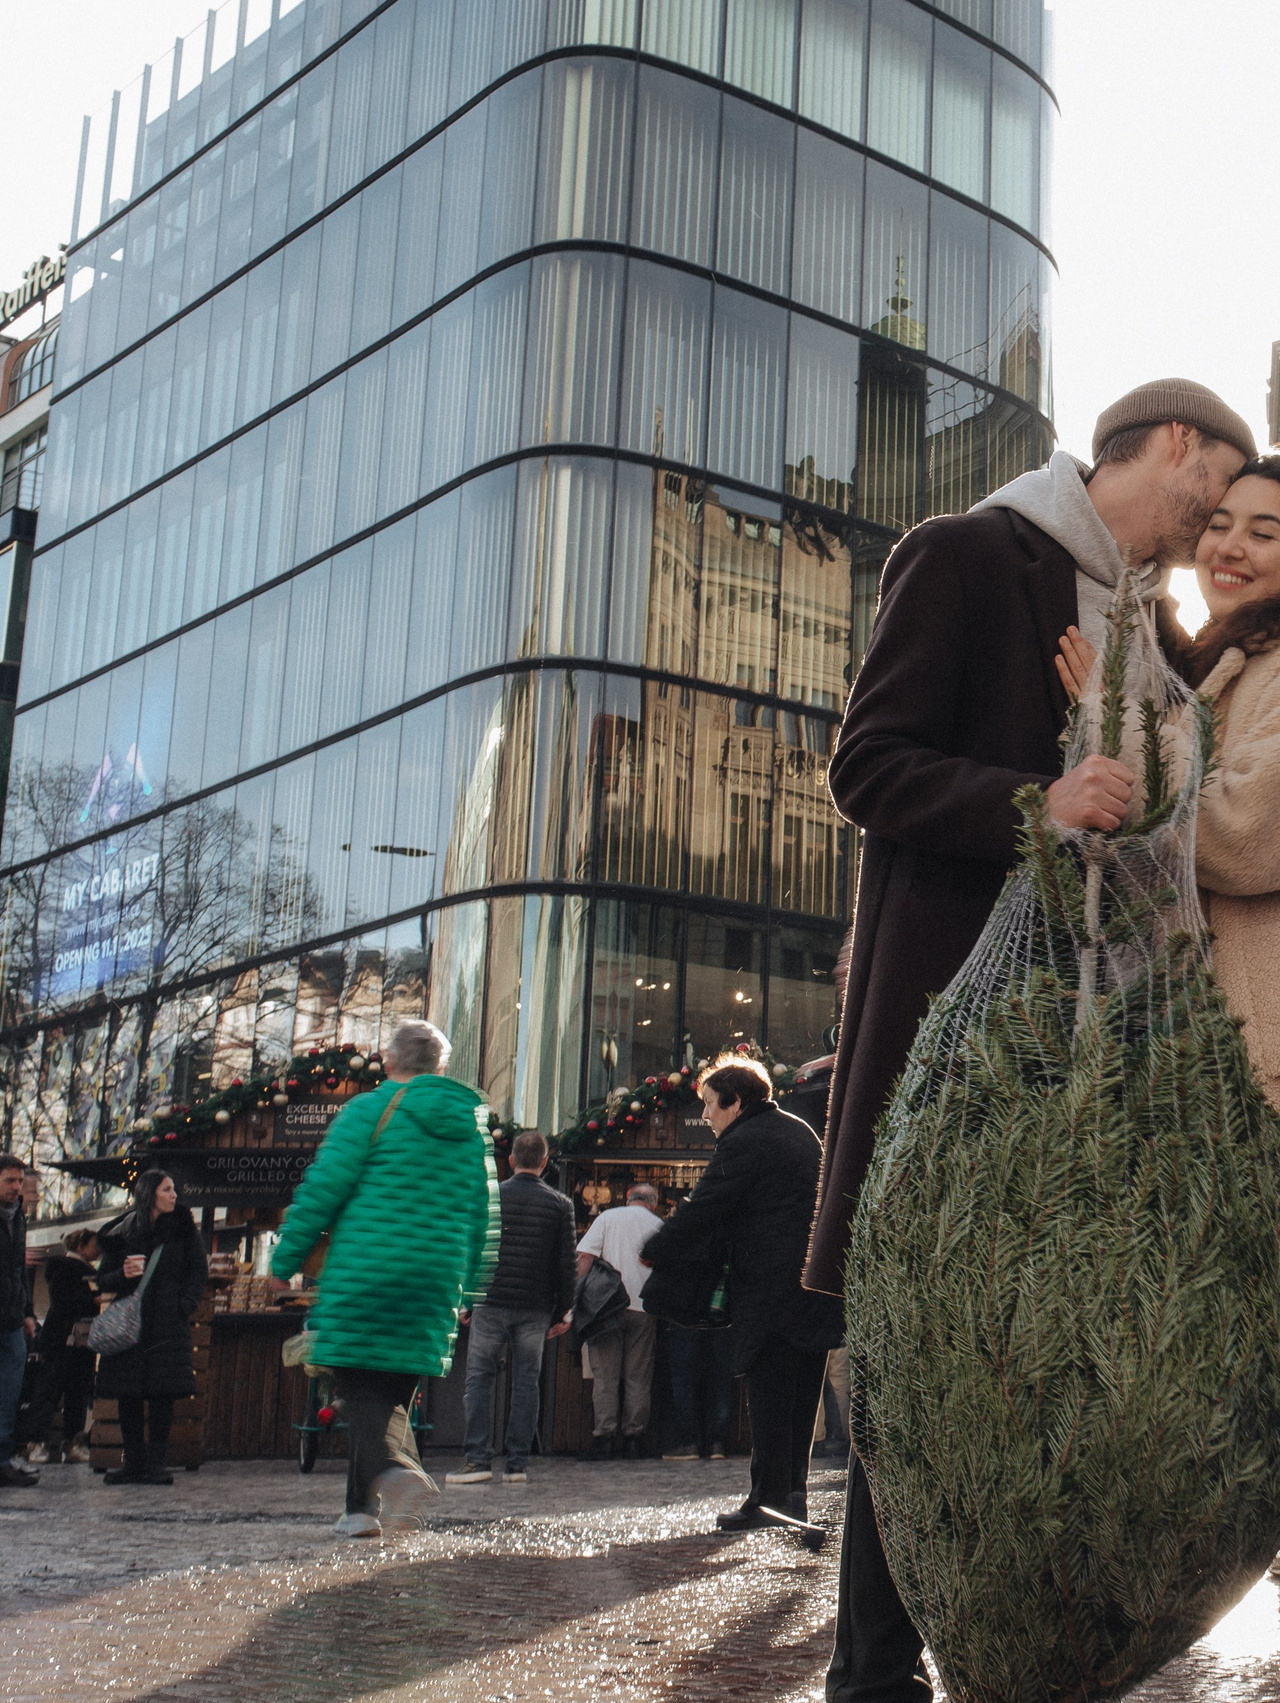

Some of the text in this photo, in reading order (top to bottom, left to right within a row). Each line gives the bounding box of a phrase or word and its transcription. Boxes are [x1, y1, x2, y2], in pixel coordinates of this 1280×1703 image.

[63, 852, 160, 912] MY CABARET
[55, 941, 100, 972] OPENNG
[285, 1113, 328, 1125] CHEESE
[684, 1118, 708, 1127] www.
[226, 1170, 286, 1182] GRILLED
